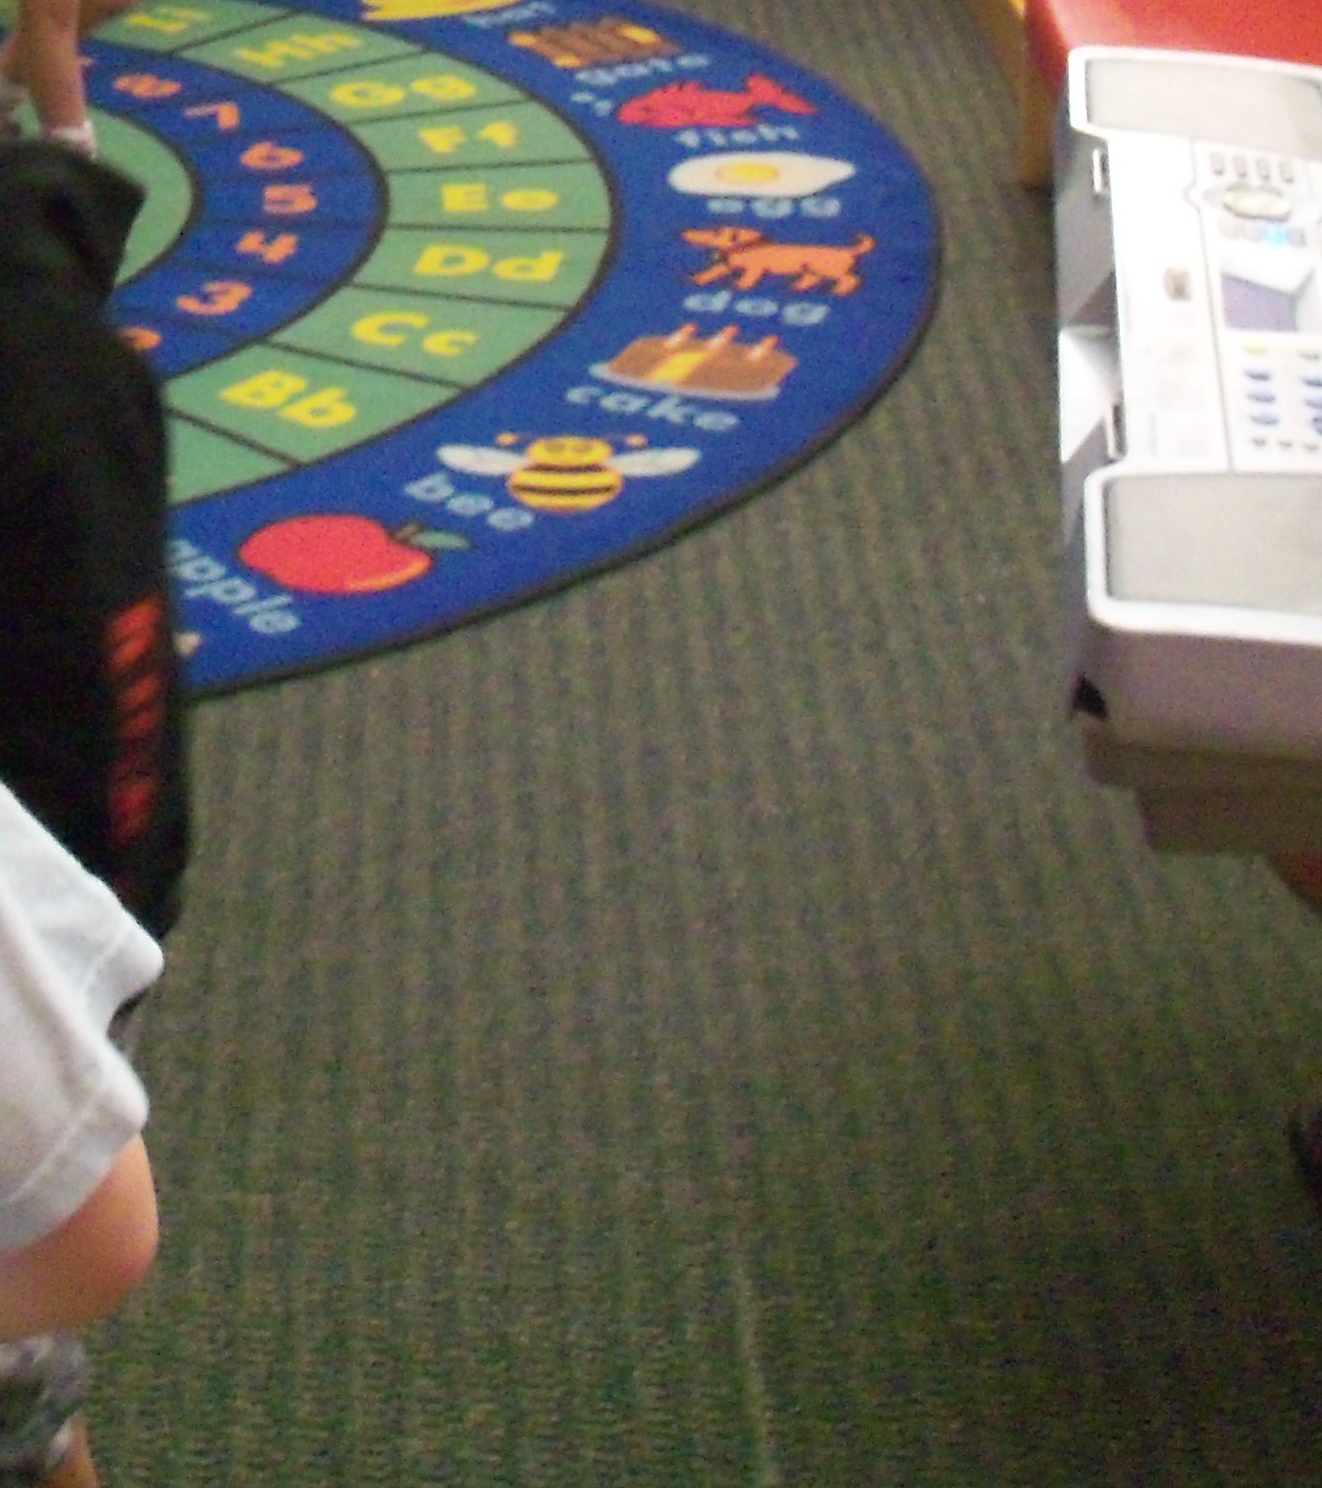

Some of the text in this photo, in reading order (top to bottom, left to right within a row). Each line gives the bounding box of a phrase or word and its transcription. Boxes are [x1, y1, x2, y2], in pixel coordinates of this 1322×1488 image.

[233, 31, 364, 69] Hh
[112, 72, 182, 99] 8
[329, 75, 476, 108] Gg
[184, 100, 240, 130] 7
[418, 120, 520, 154] Ff
[676, 122, 800, 149] fish
[240, 140, 304, 170] 6
[263, 184, 318, 215] 5
[441, 183, 558, 213] Ee
[706, 196, 841, 219] egg
[236, 229, 299, 264] 4
[413, 244, 565, 283] Dd
[176, 281, 253, 316] 3
[682, 289, 830, 327] dog
[351, 313, 477, 357] Cc
[218, 370, 358, 428] Bb
[566, 385, 740, 433] cake
[405, 472, 535, 533] bee
